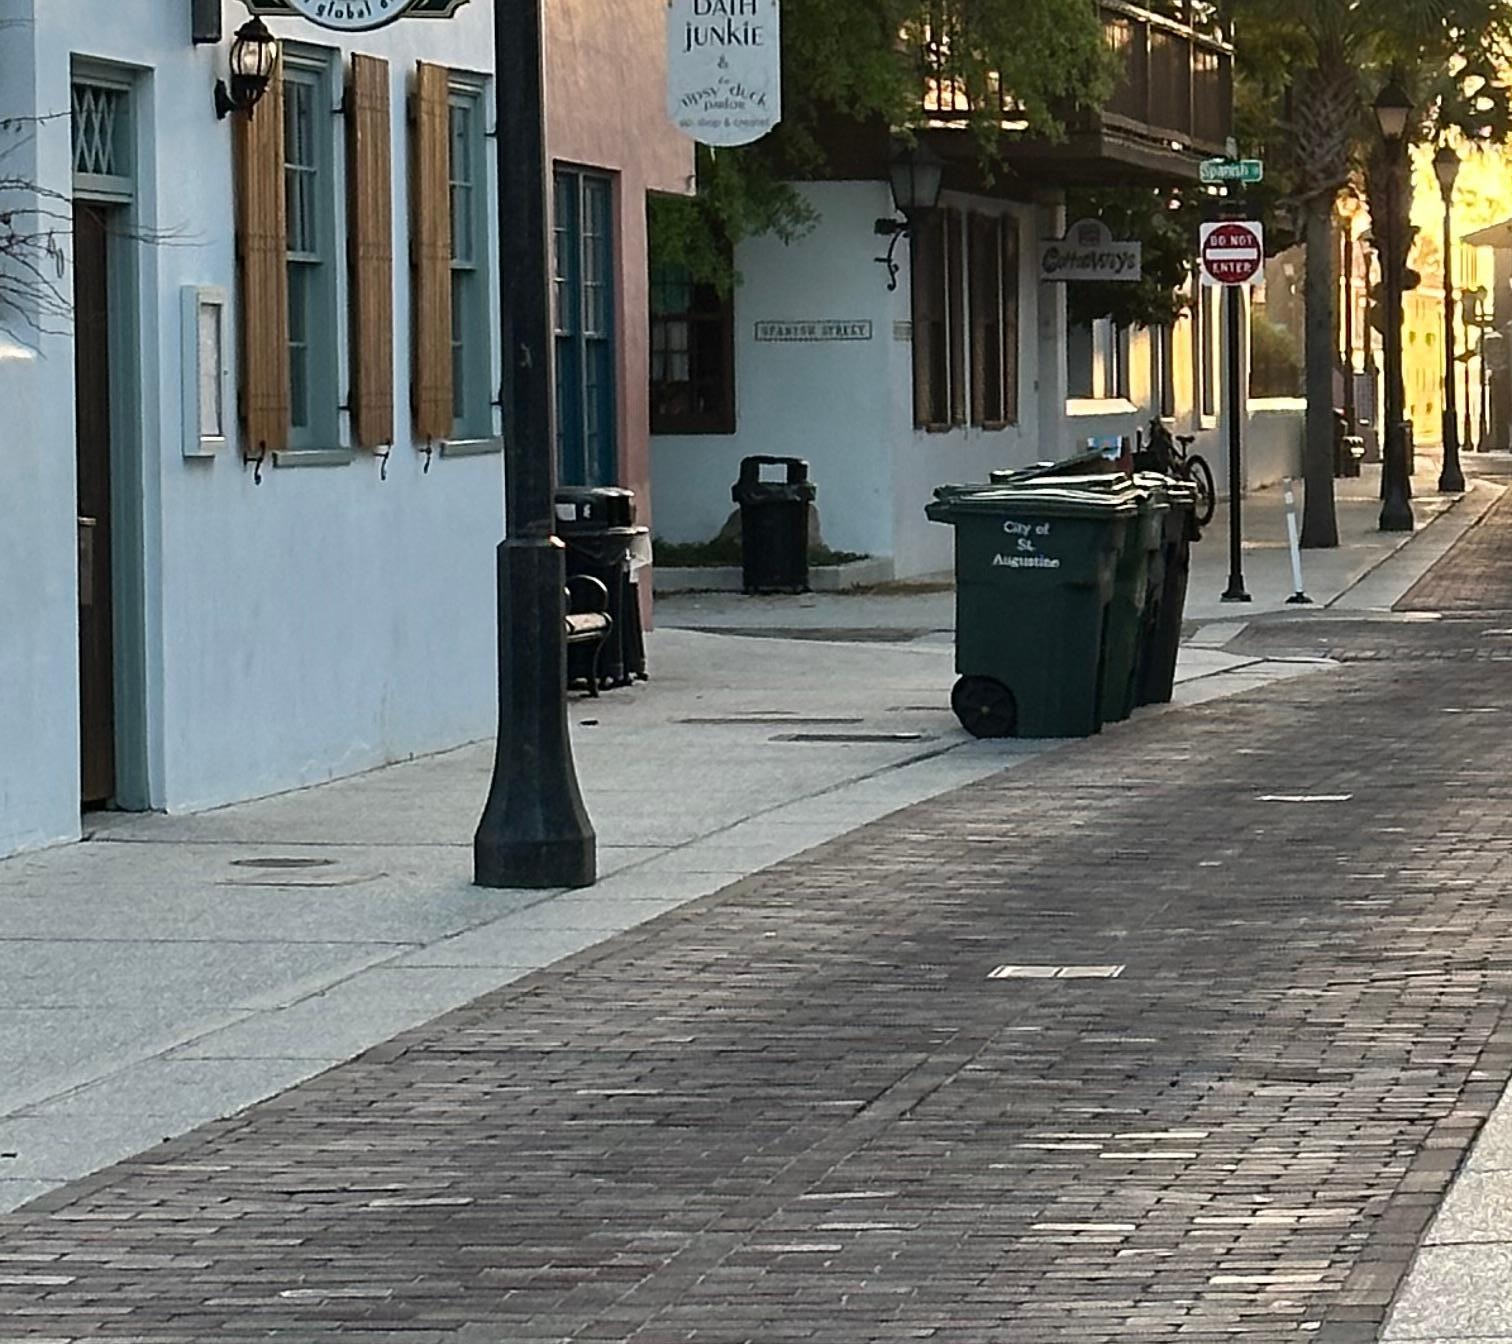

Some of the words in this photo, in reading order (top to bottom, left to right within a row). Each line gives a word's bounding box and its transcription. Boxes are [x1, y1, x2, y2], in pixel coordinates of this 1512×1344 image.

[315, 0, 372, 20] global
[1210, 236, 1226, 247] DO
[1230, 235, 1253, 247] NOT
[1212, 262, 1252, 273] ENTER
[760, 324, 816, 337] SPANISH
[1003, 520, 1031, 536] City
[1035, 522, 1050, 535] of
[991, 553, 1060, 568] Augustine
